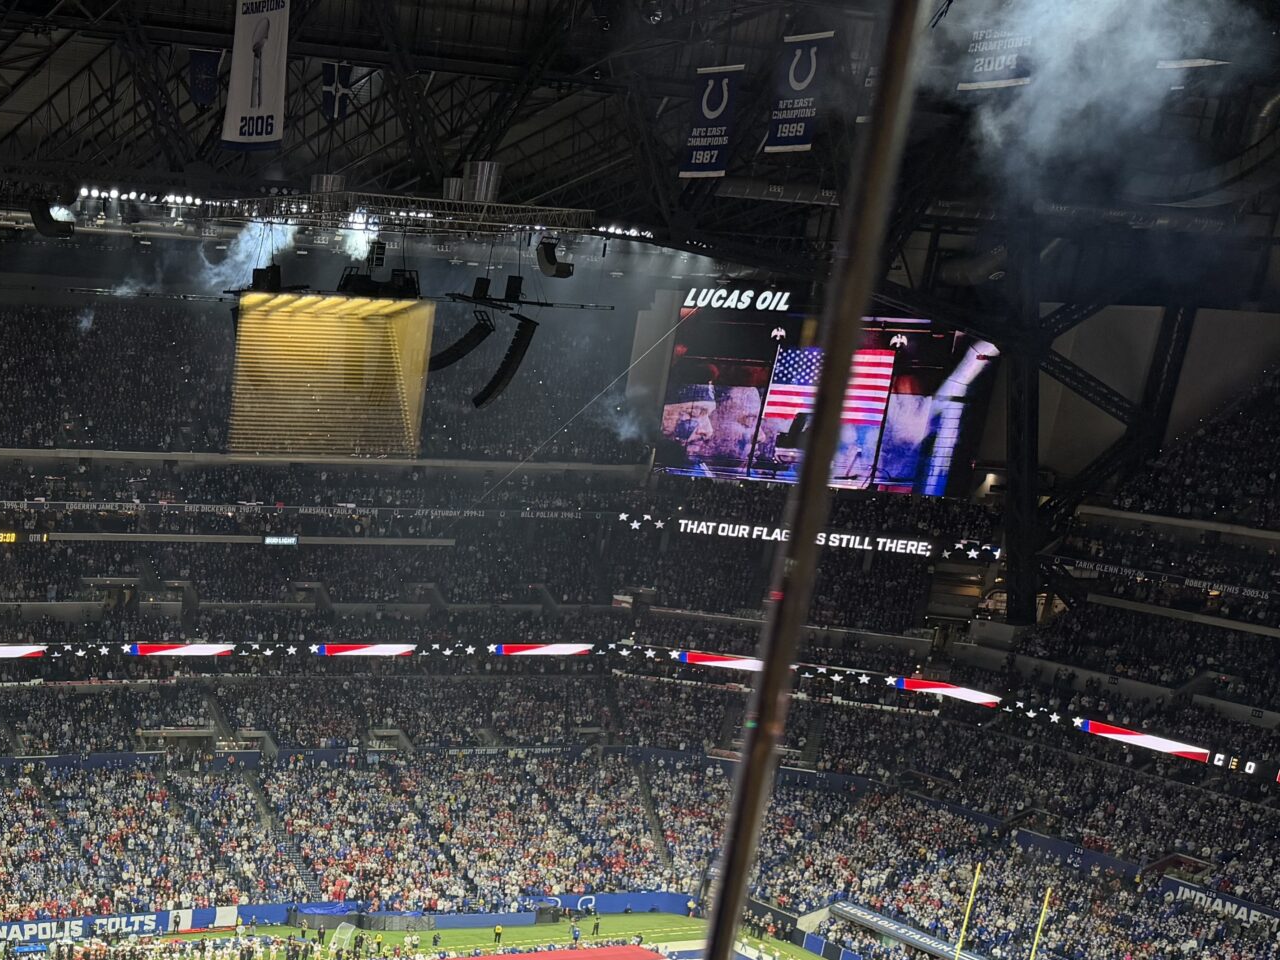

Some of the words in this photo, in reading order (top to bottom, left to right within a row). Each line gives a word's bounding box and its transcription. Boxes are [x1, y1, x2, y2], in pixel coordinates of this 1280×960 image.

[241, 0, 286, 14] CHAMPIONS
[968, 36, 1033, 53] CHAMPIONS
[795, 97, 816, 108] EAST
[772, 107, 817, 120] CHAMPIONS
[239, 115, 274, 136] 2006
[706, 126, 727, 136] EAST
[776, 122, 806, 138] 1999
[686, 136, 729, 147] CHAMPIONS
[690, 150, 718, 164] 1987
[683, 287, 754, 310] LUCAS
[755, 290, 791, 311] OIL
[678, 519, 717, 535] THAT
[717, 522, 750, 538] OUR
[828, 533, 873, 551] STILL
[876, 537, 933, 557] THERE;
[1184, 578, 1211, 590] ROBERT
[1213, 582, 1240, 594] MATHIS
[95, 915, 157, 935] COLTS
[843, 905, 877, 923] LUCAS
[877, 919, 899, 933] OIL
[898, 927, 953, 951] STADIUM
